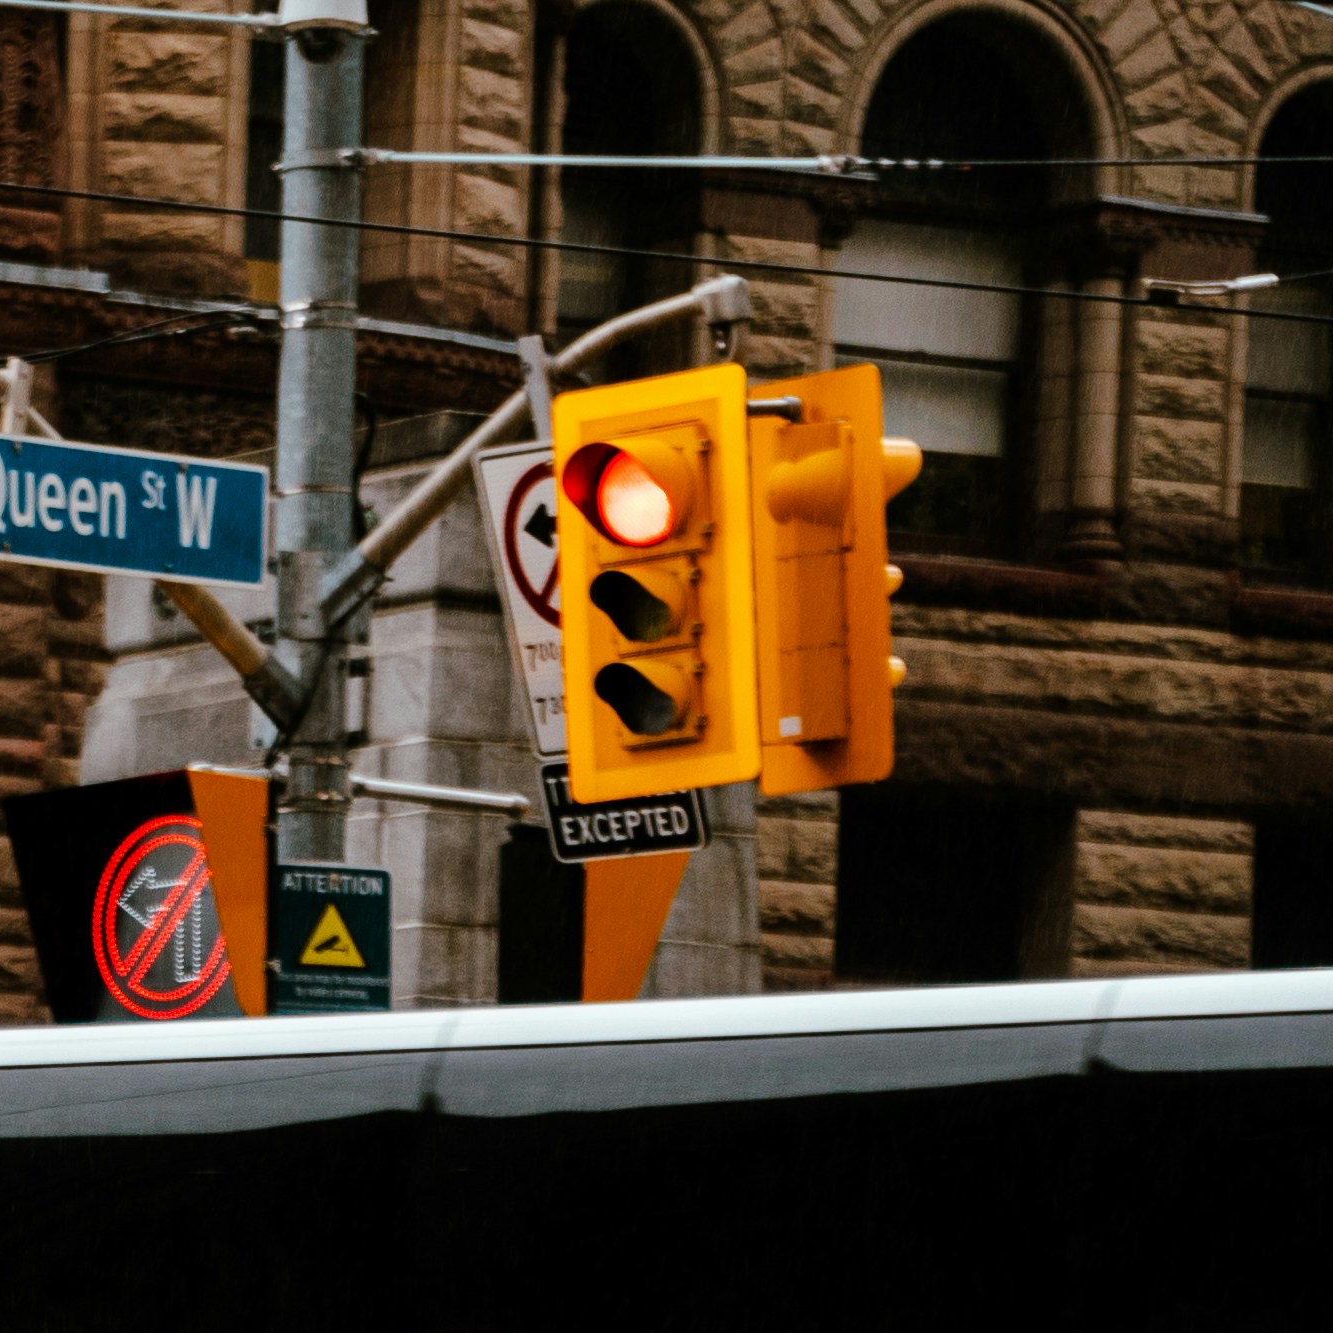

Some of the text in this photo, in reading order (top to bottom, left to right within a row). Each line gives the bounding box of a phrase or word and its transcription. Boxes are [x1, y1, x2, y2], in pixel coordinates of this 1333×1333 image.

[141, 470, 167, 510] St
[175, 472, 218, 551] W
[560, 804, 690, 847] EXCEPTED
